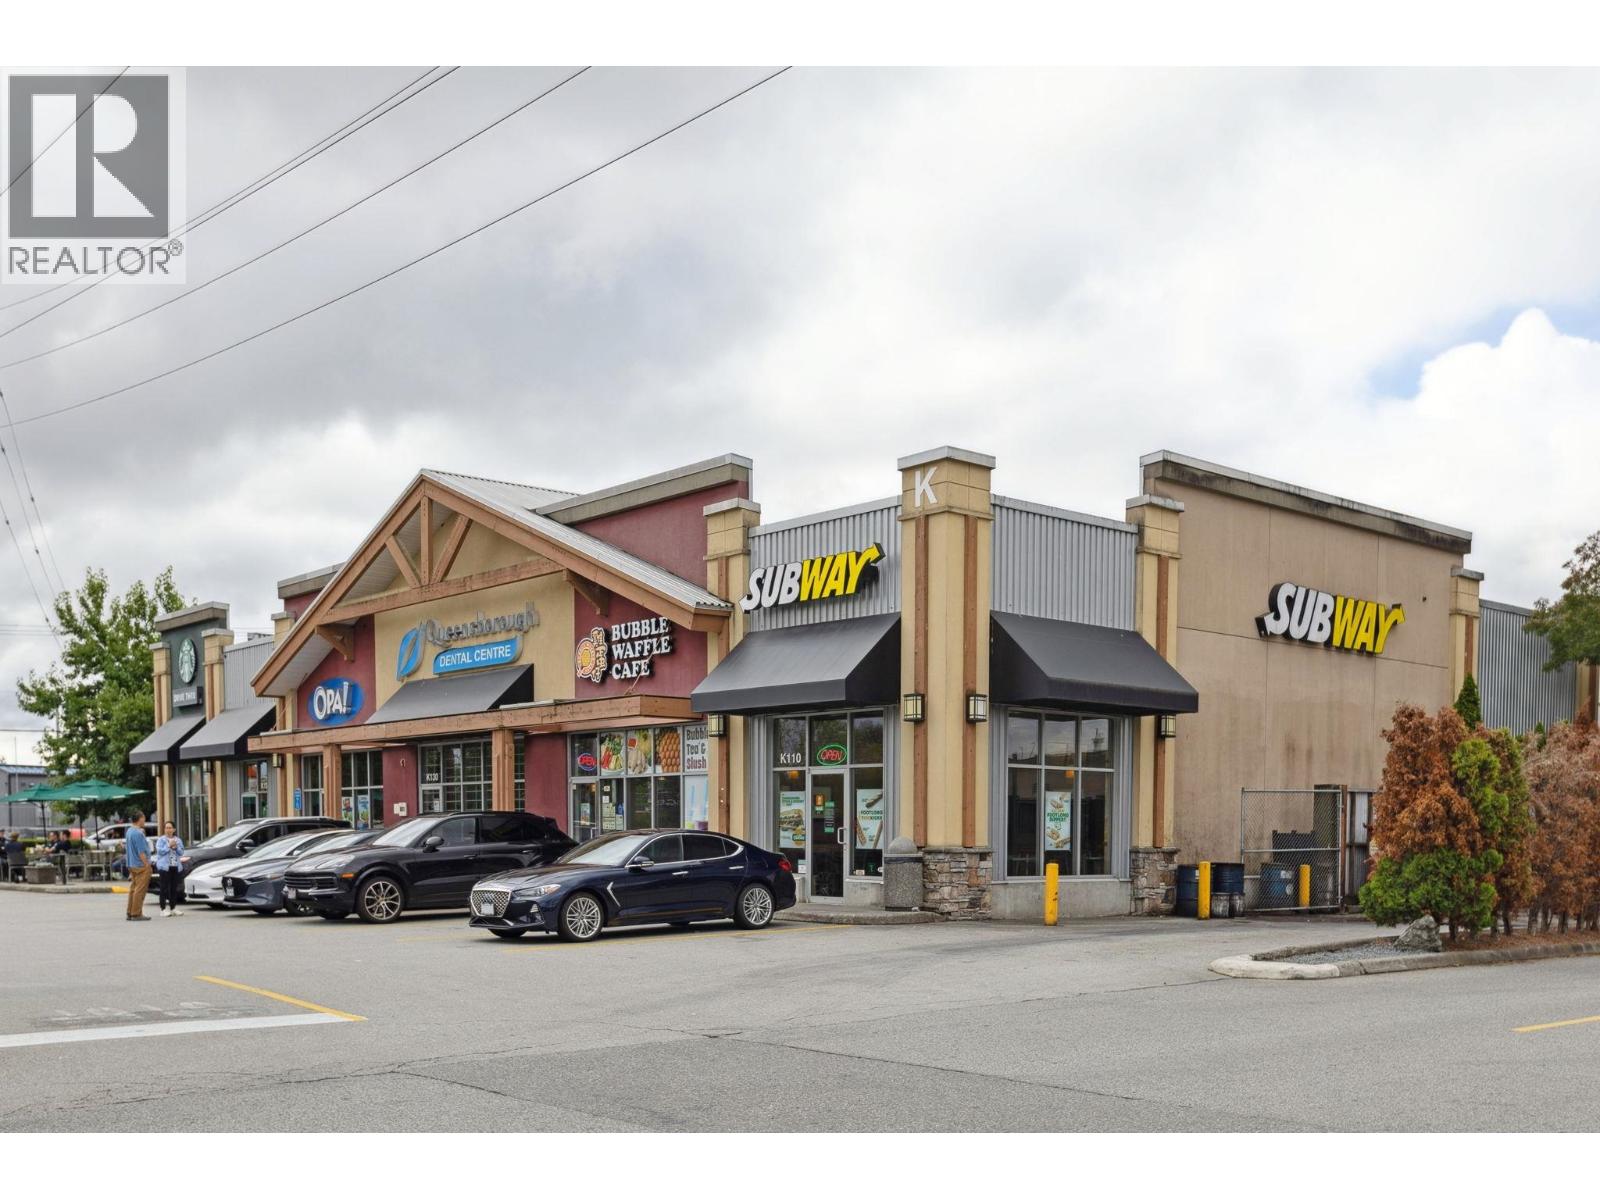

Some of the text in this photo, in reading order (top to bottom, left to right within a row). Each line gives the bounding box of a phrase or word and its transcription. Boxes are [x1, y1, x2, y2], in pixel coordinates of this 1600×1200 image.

[914, 466, 938, 508] K
[738, 542, 884, 613] SUBWAY
[426, 600, 540, 649] Queensborough
[611, 616, 670, 642] BUBBLE
[1260, 582, 1406, 655] SUBWAY
[439, 644, 512, 668] DENTAL CENTRE
[611, 635, 671, 659] WAFFLE
[611, 659, 650, 680] CAFE
[313, 681, 349, 720] OPA!
[686, 743, 699, 755] Tea
[780, 752, 802, 764] K110
[820, 749, 842, 761] OPEN
[686, 757, 707, 770] Slush
